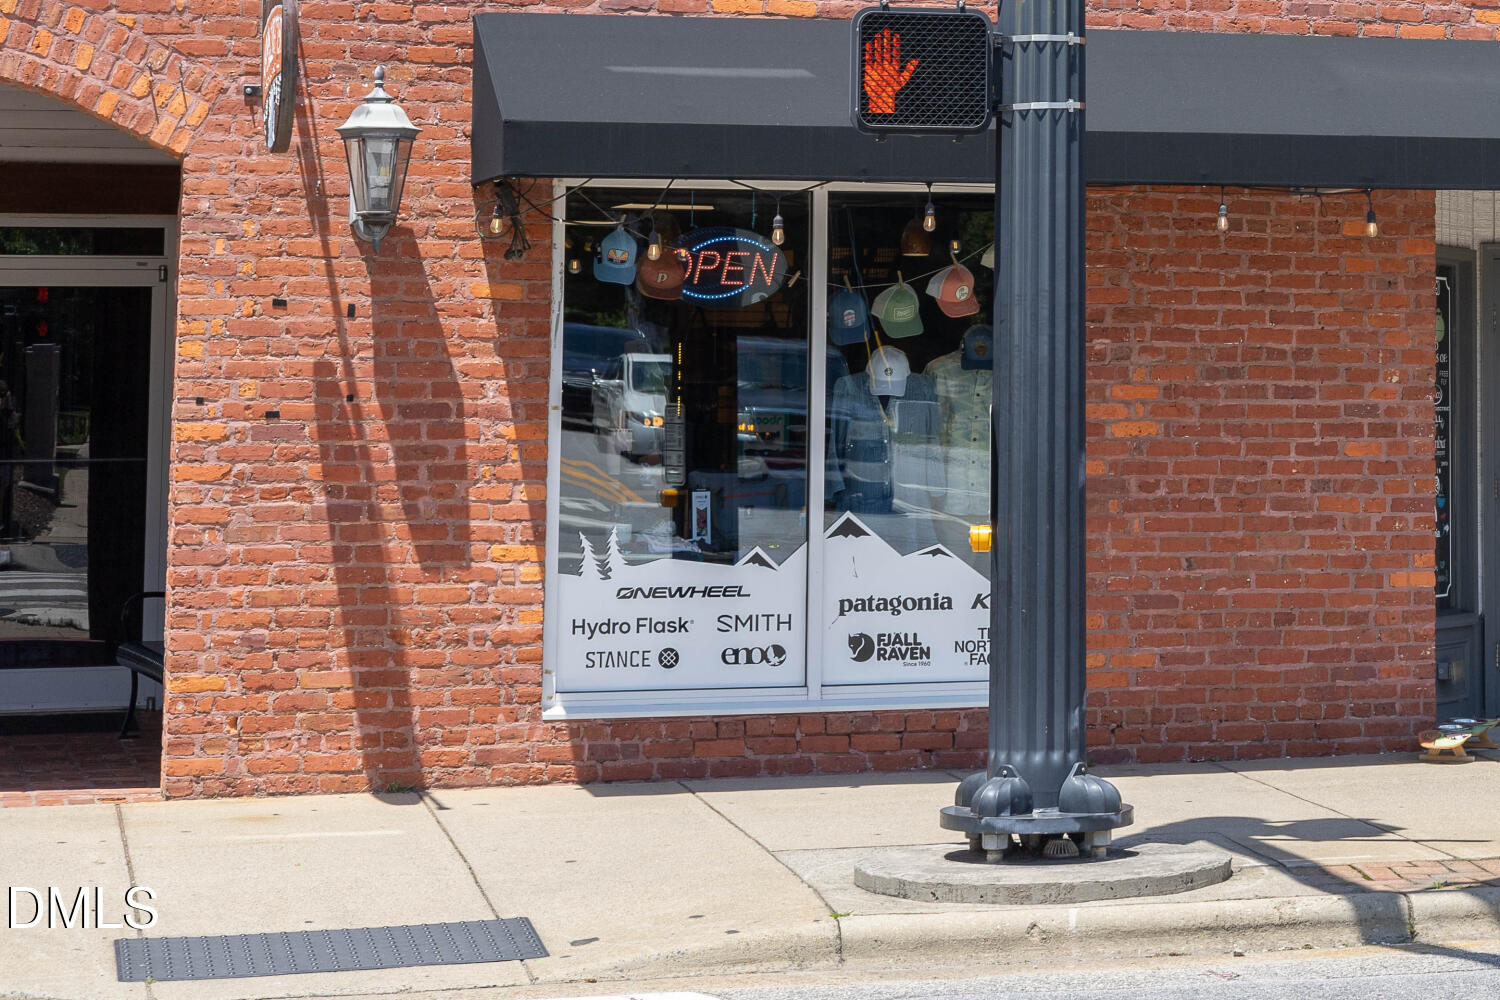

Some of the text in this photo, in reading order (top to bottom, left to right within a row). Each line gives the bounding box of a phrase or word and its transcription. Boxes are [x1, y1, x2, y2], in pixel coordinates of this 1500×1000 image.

[616, 585, 750, 600] ONEWHEEL
[838, 592, 953, 616] patagonia
[572, 617, 689, 640] Hydro Flask
[717, 614, 792, 633] SMITH
[977, 627, 991, 640] T
[585, 651, 651, 668] STANCE
